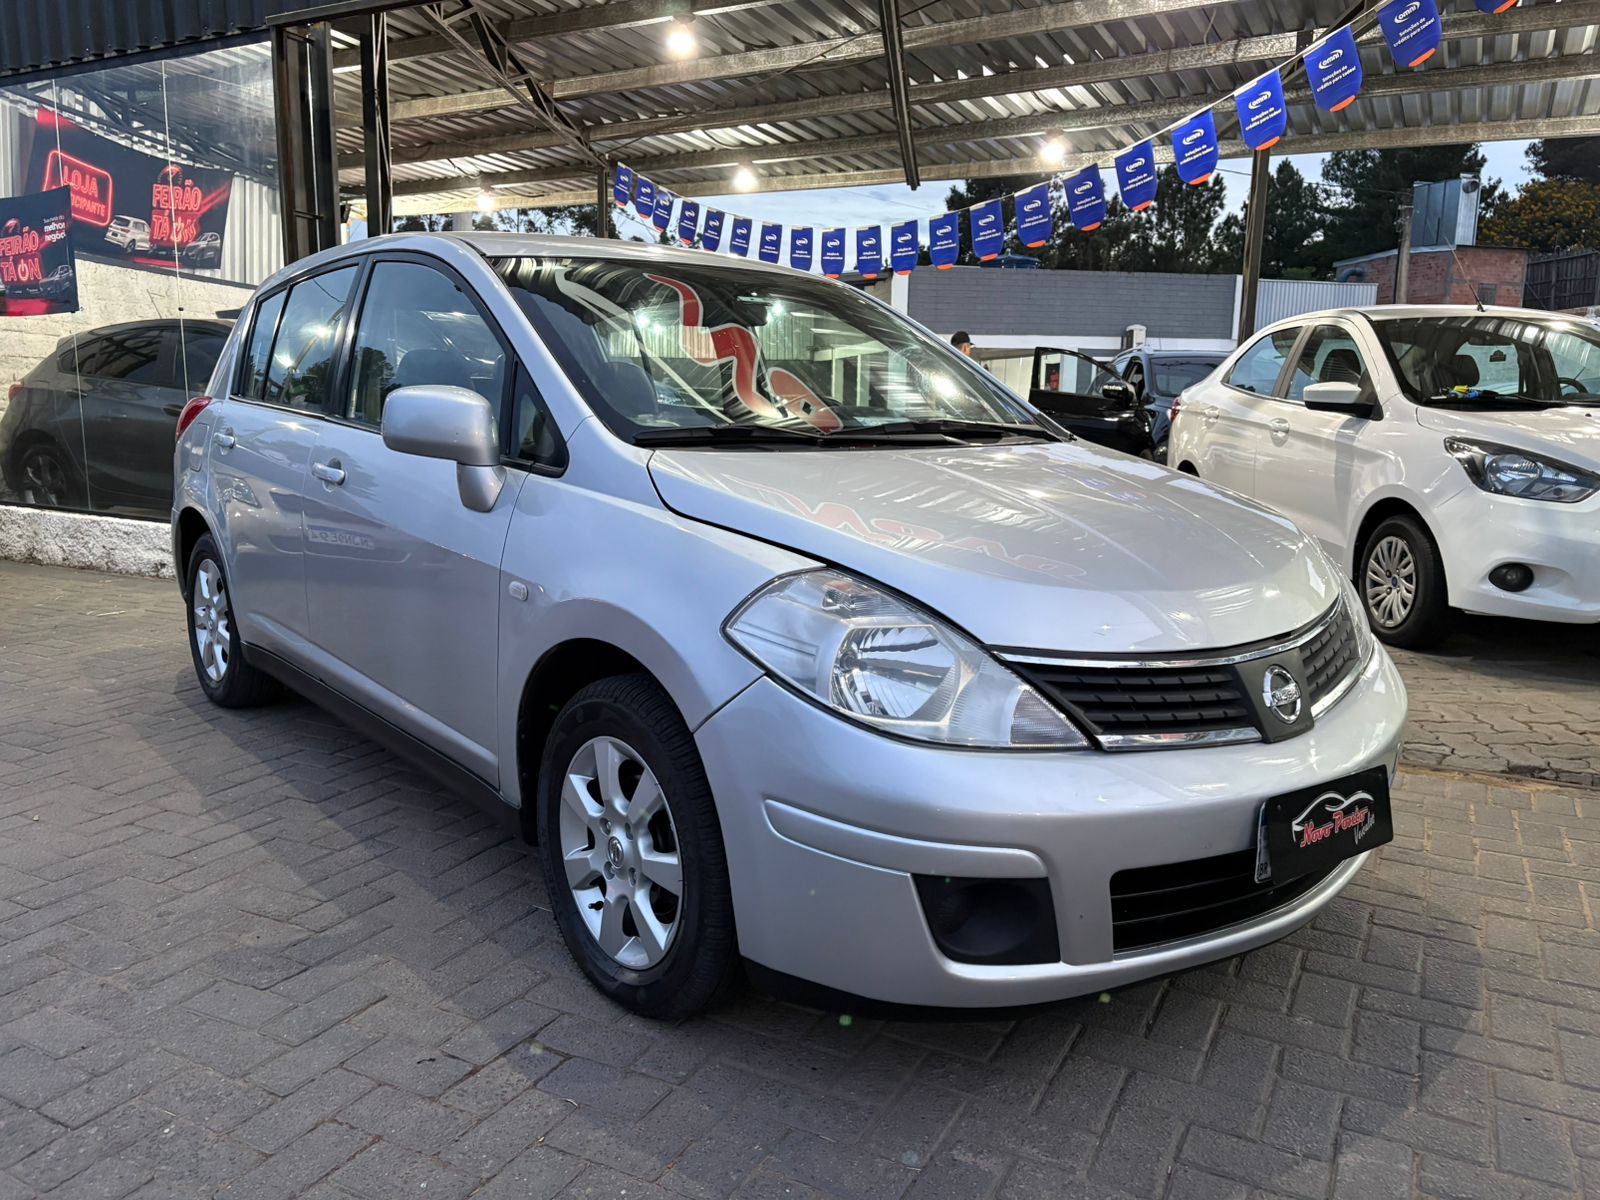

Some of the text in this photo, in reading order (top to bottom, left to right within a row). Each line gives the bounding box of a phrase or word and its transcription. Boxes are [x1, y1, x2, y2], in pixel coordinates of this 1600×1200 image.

[63, 165, 98, 198] LOJA
[152, 179, 202, 211] FEIRÃO
[152, 210, 170, 240] TÁ
[0, 226, 39, 257] FEIRÃO
[1, 256, 17, 282] TÁ
[1300, 819, 1334, 848] Novo
